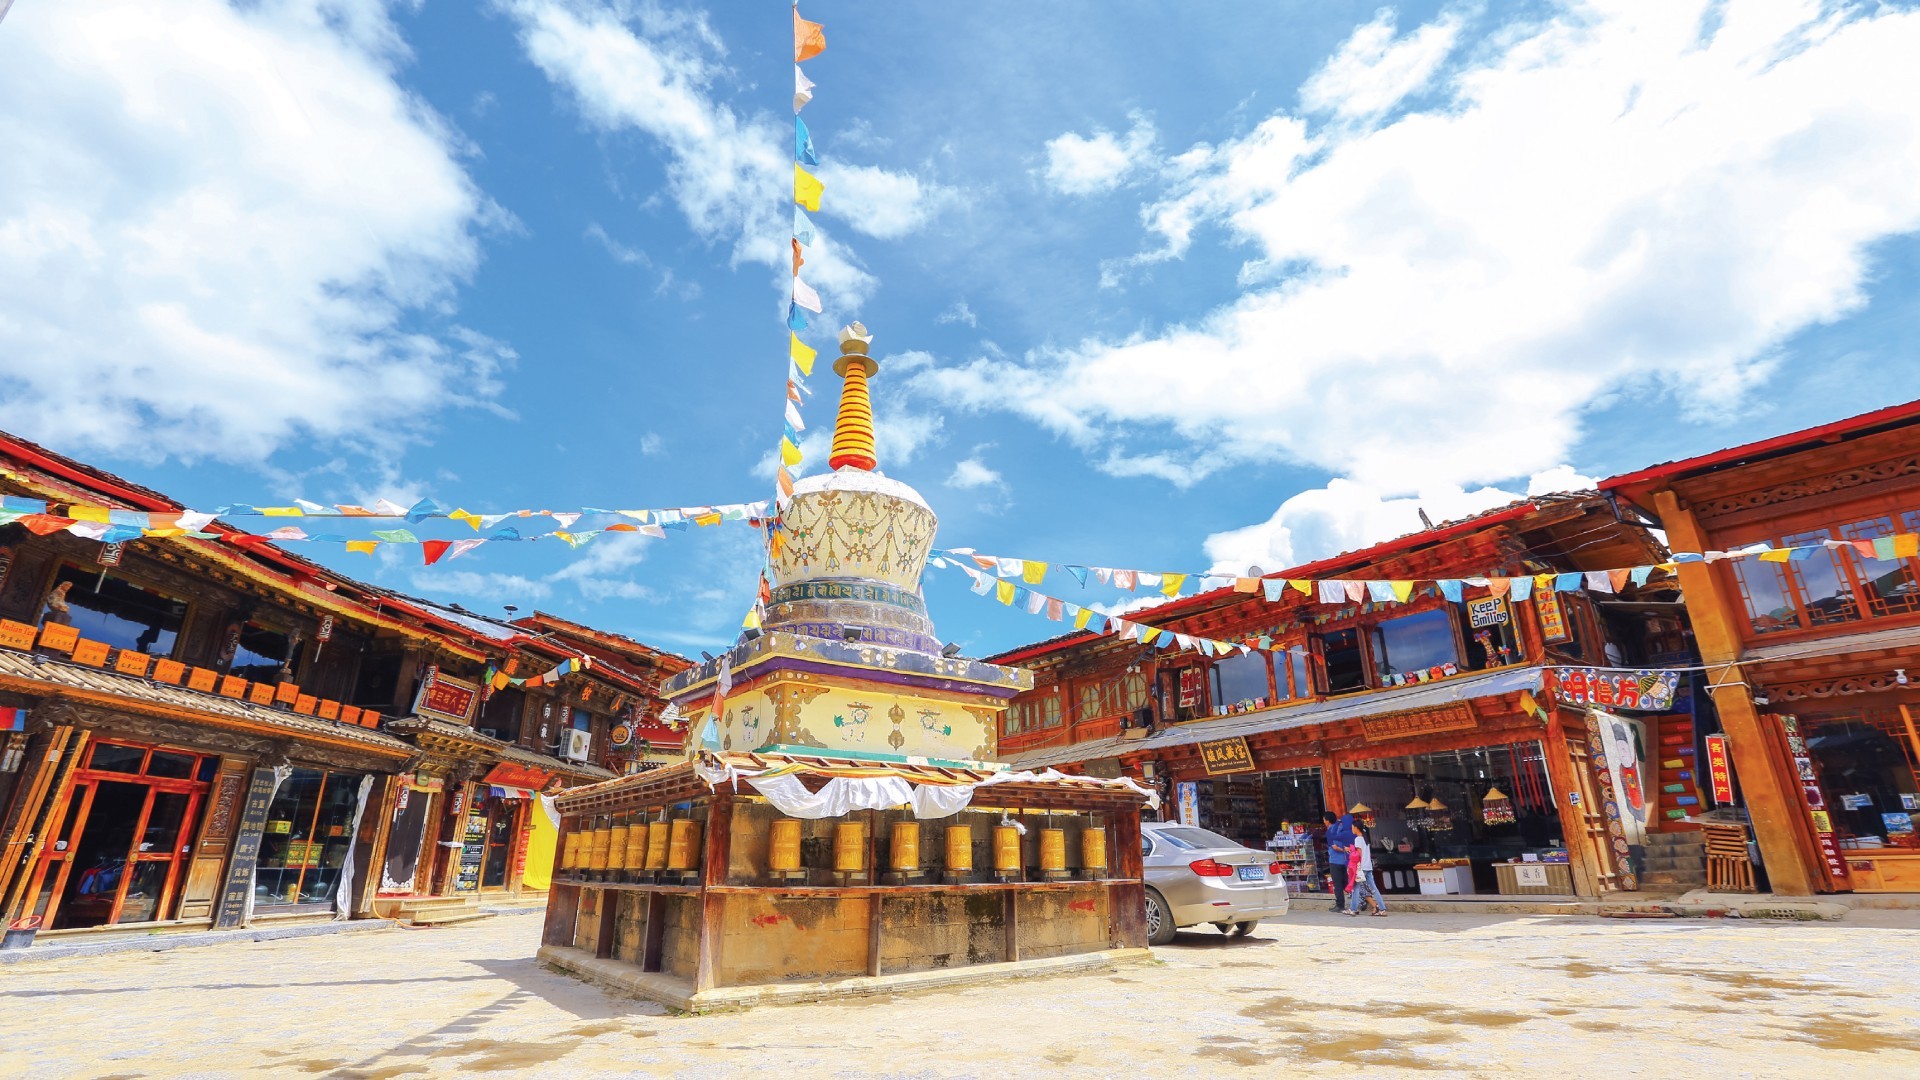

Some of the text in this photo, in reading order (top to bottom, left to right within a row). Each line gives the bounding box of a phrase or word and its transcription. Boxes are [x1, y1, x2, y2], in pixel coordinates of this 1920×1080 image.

[1471, 611, 1507, 627] Smiling
[1, 621, 23, 634] Indian
[122, 651, 146, 664] Snacks
[1710, 742, 1729, 796] 各类特产
